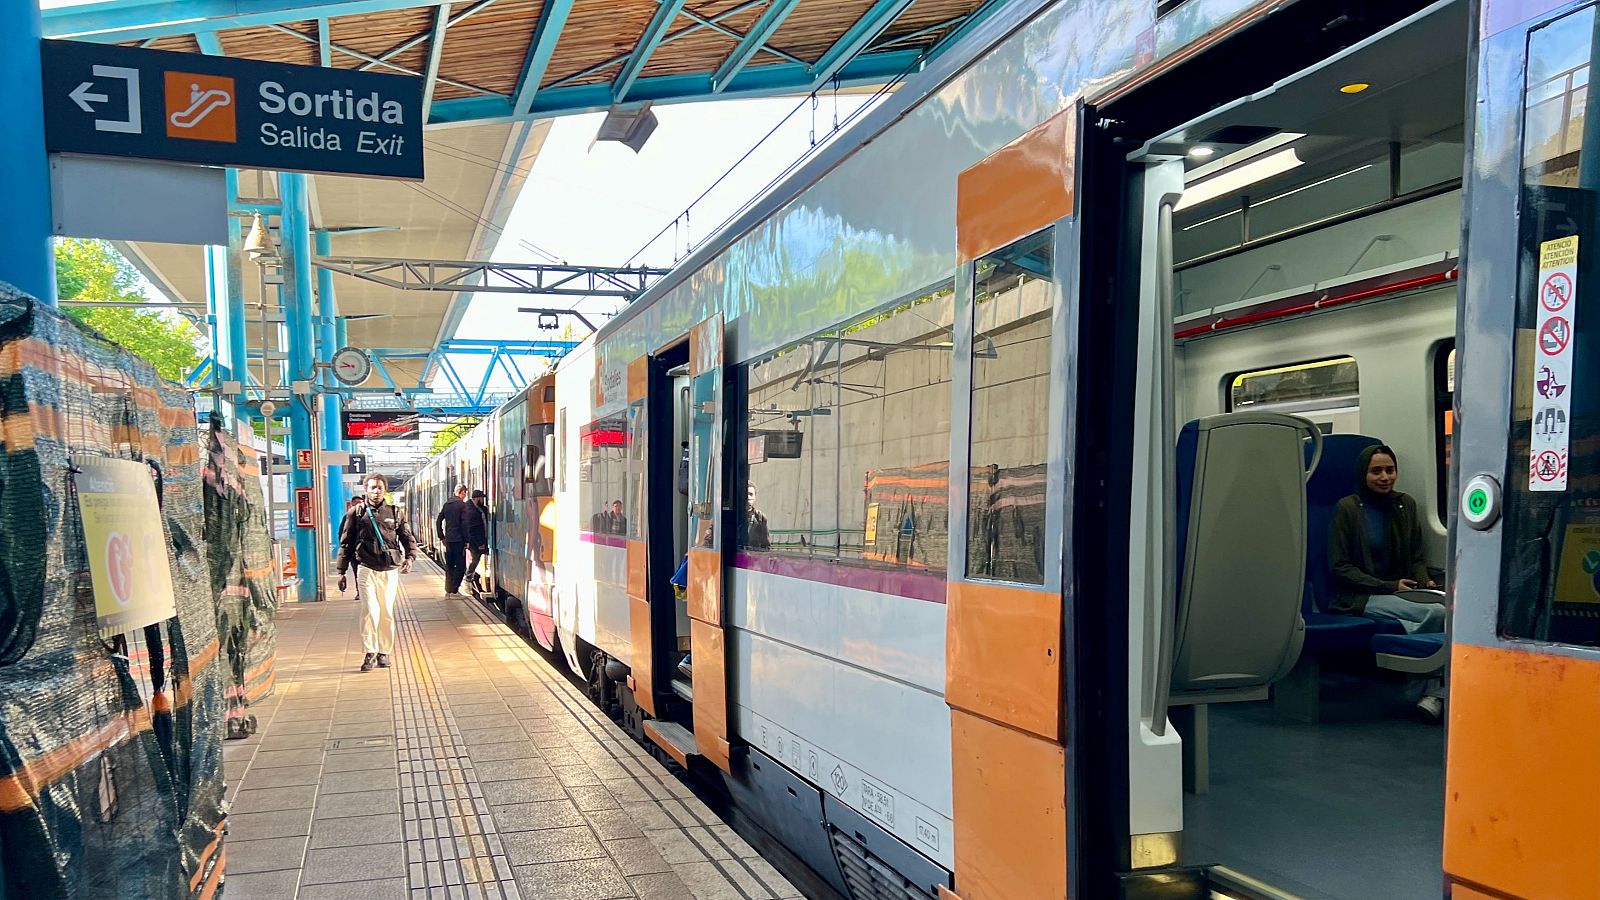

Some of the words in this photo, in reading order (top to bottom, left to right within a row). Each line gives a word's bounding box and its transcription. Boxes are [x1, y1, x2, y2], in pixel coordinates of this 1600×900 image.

[259, 81, 404, 125] Sortida
[260, 122, 342, 151] Salida
[356, 131, 405, 156] Exit
[1541, 256, 1575, 269] ATTENTION
[353, 462, 360, 473] 1
